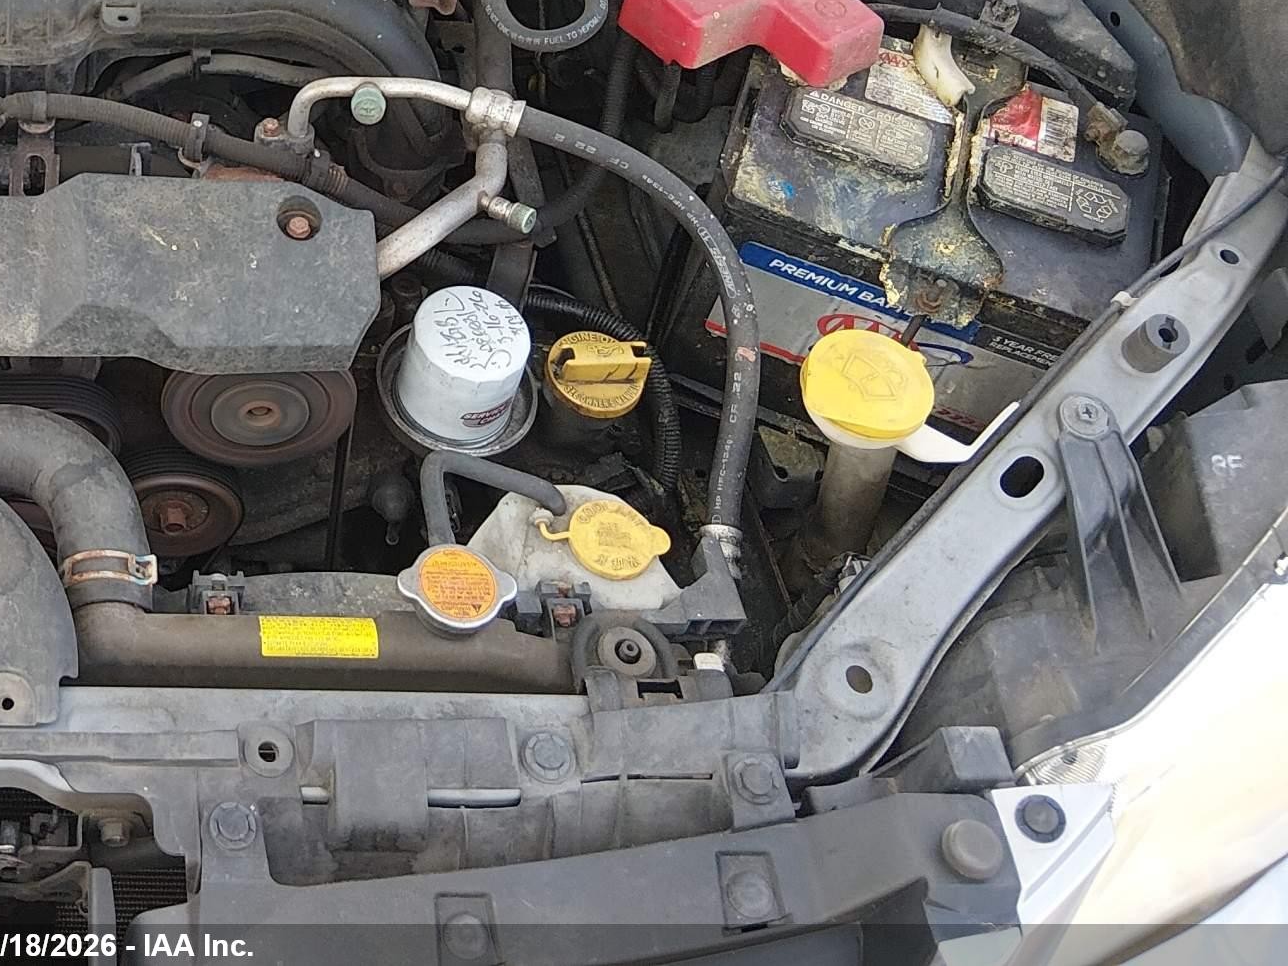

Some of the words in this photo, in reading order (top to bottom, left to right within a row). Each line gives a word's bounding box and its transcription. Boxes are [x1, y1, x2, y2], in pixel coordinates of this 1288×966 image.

[820, 92, 866, 115] DANGER
[876, 110, 919, 130] POISON
[768, 258, 856, 296] PREMIUM
[988, 341, 1054, 366] REPLACEMEN
[1002, 337, 1035, 353] YEAR
